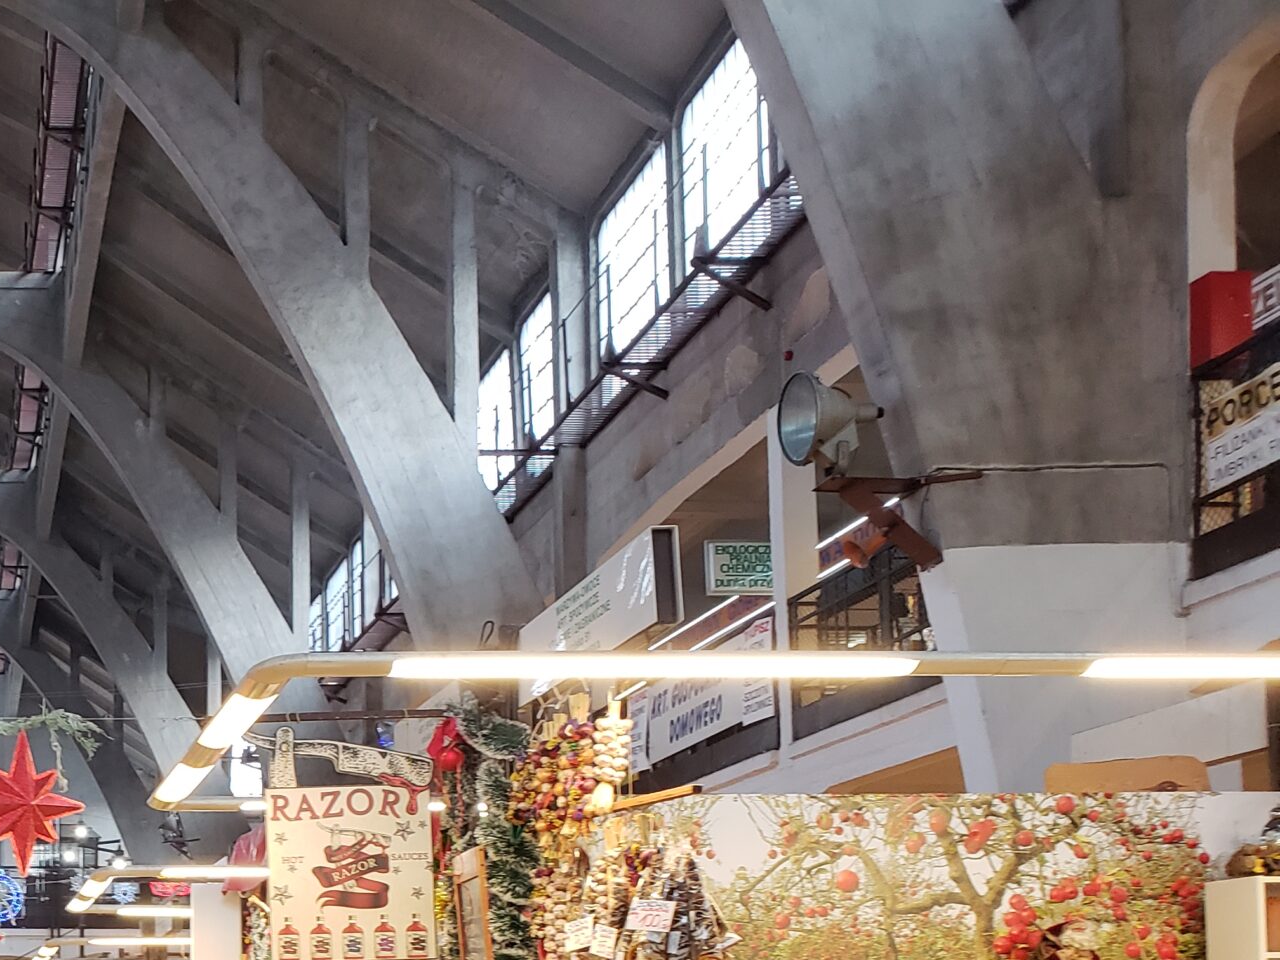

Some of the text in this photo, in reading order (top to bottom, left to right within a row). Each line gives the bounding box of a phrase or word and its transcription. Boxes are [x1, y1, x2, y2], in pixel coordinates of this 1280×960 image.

[715, 545, 771, 555] EKOLOGICZ
[670, 694, 723, 743] DOMOWEGO
[270, 788, 402, 822] RAZOR
[281, 852, 429, 864] HOT SAUCES
[331, 857, 379, 883] RAZOR
